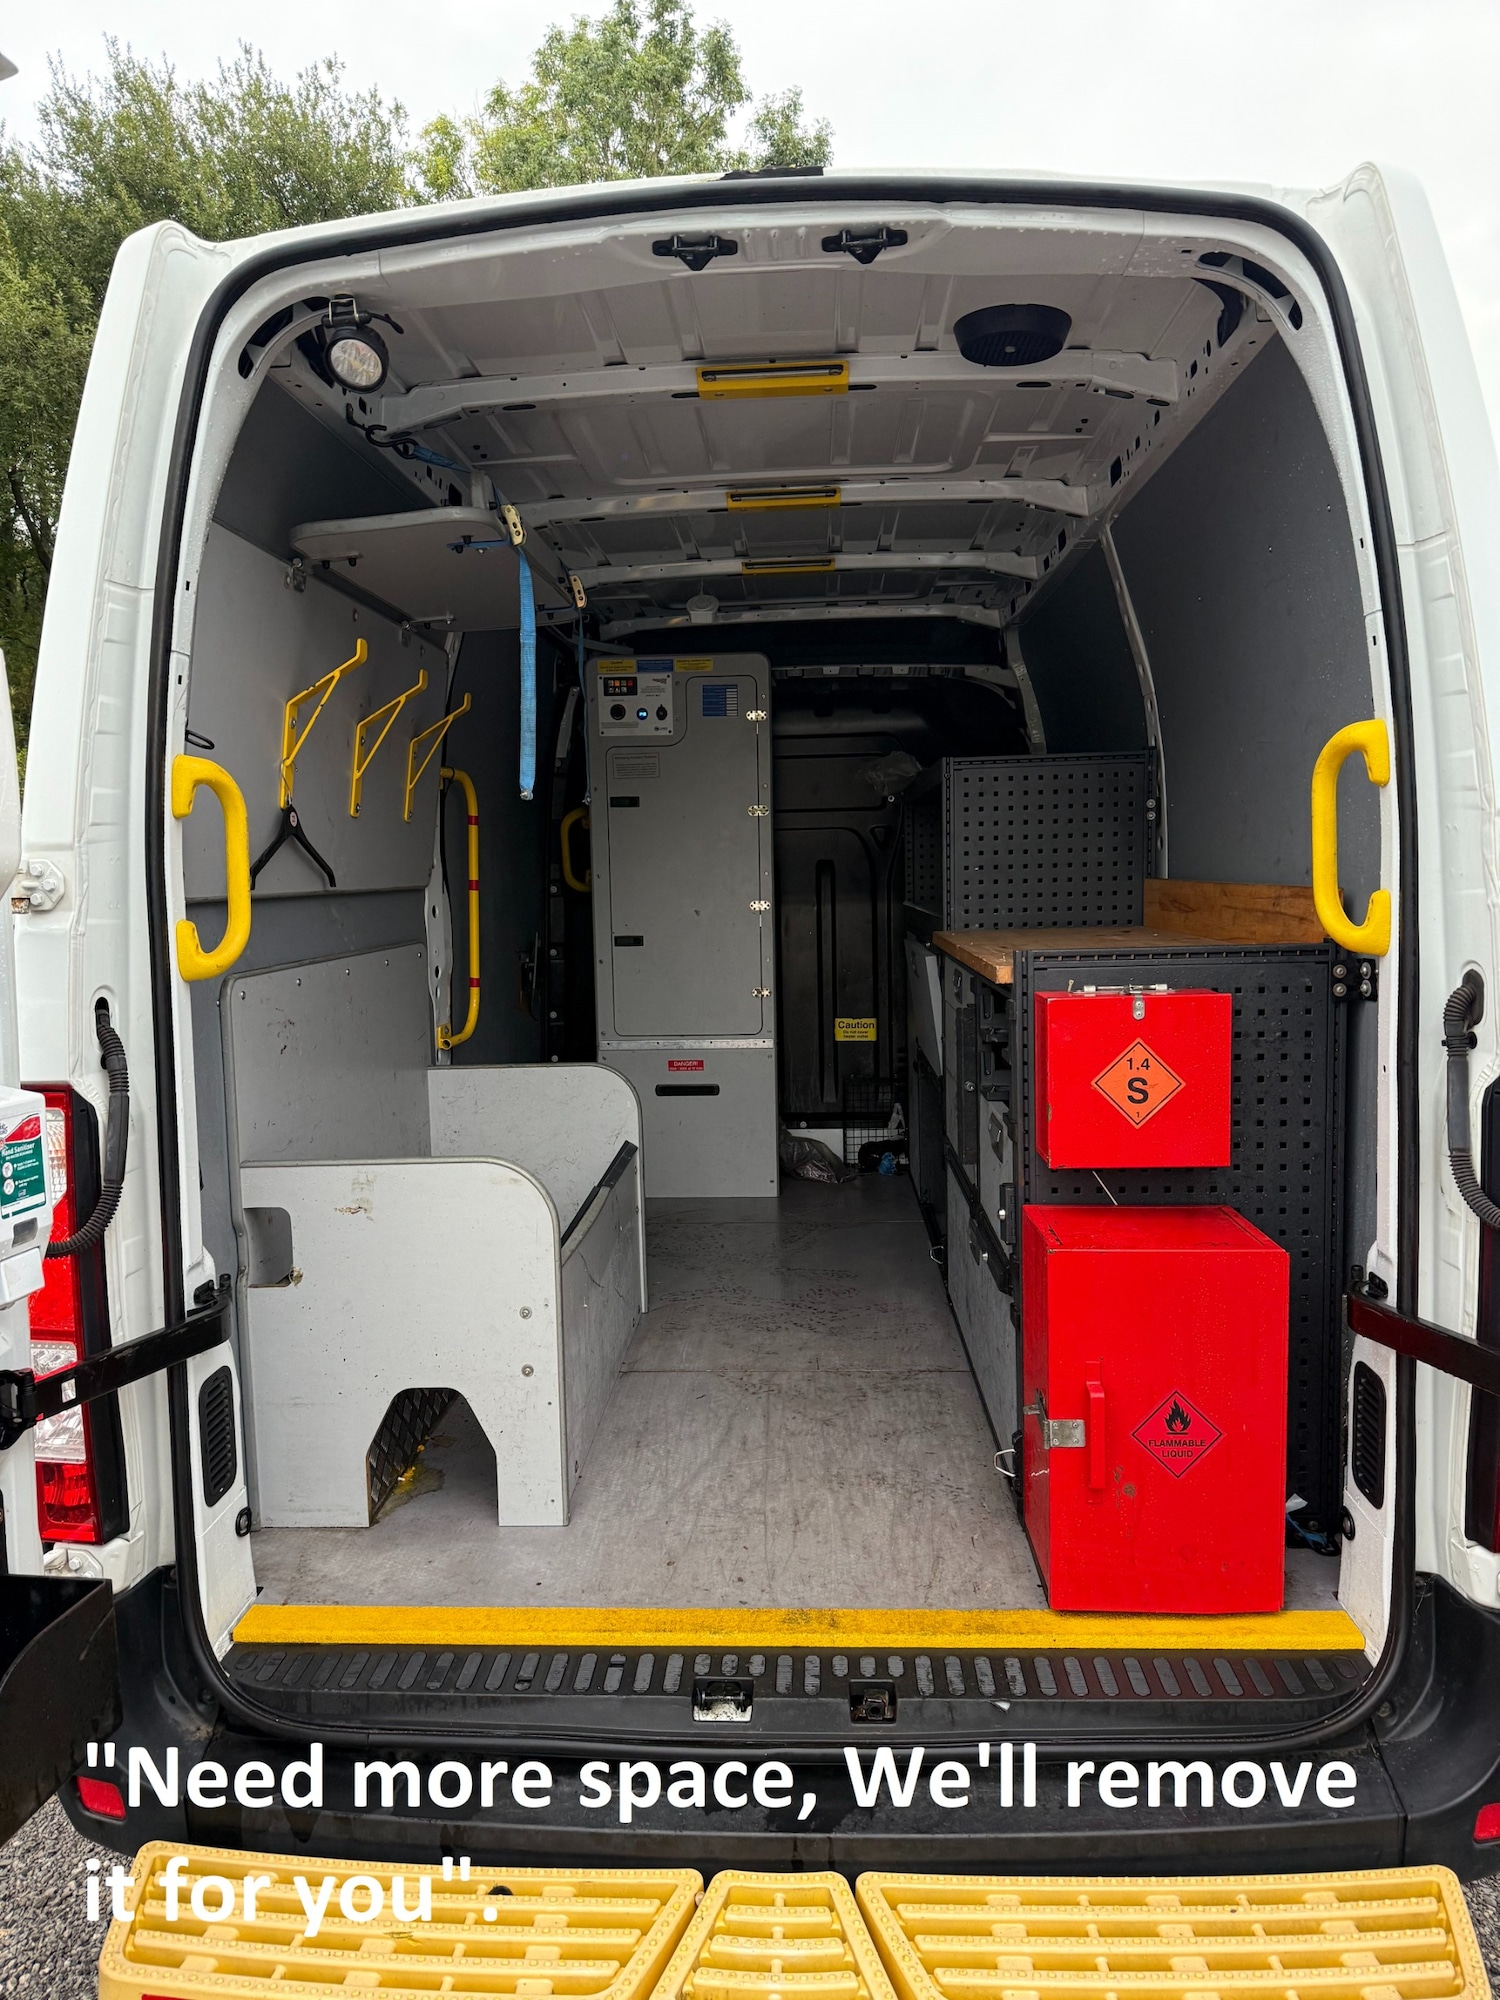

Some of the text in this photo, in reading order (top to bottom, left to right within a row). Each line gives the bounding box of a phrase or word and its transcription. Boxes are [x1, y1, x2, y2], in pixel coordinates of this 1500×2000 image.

[838, 1021, 874, 1029] Caution
[1126, 1058, 1151, 1071] 1.4
[1127, 1077, 1149, 1105] S
[1161, 1450, 1194, 1458] LIQUID
